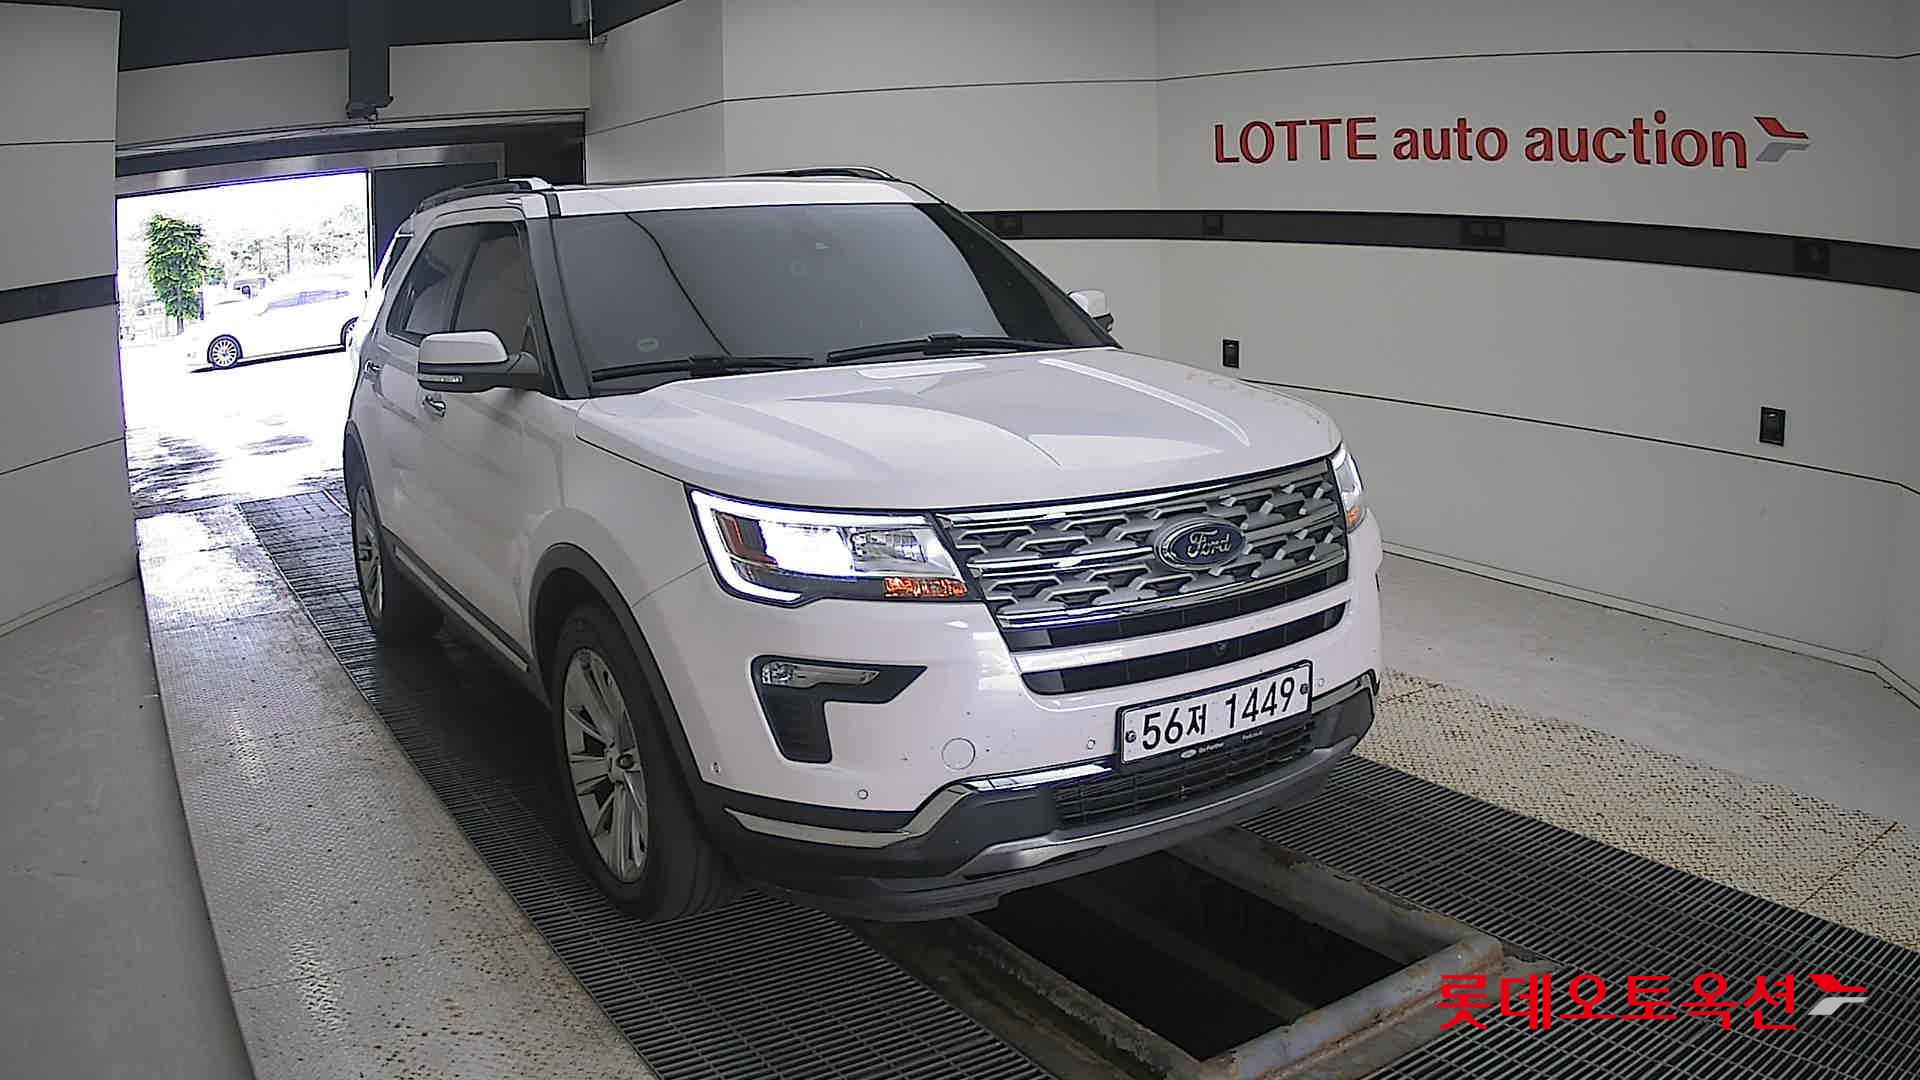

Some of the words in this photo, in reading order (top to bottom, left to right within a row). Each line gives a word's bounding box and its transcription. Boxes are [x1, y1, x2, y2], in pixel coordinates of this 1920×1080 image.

[1214, 116, 1377, 163] LOTTE
[1393, 117, 1508, 162] auto
[1524, 110, 1748, 169] auction
[1186, 528, 1232, 558] Ford
[1141, 703, 1207, 750] 56저
[1225, 676, 1296, 729] 1449
